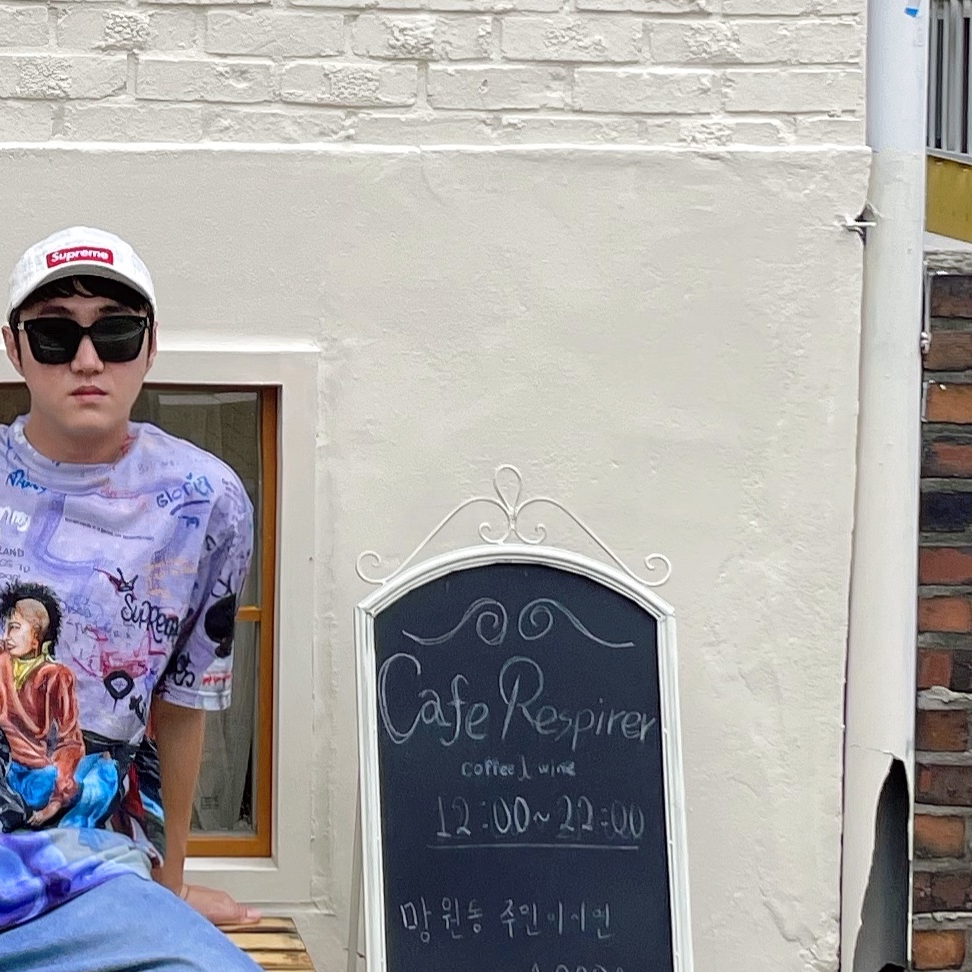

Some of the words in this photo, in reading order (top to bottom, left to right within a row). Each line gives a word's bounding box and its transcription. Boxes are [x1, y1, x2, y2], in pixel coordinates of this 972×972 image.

[51, 249, 109, 262] Supreme
[378, 652, 488, 746] Cafe
[499, 655, 656, 752] Respirer
